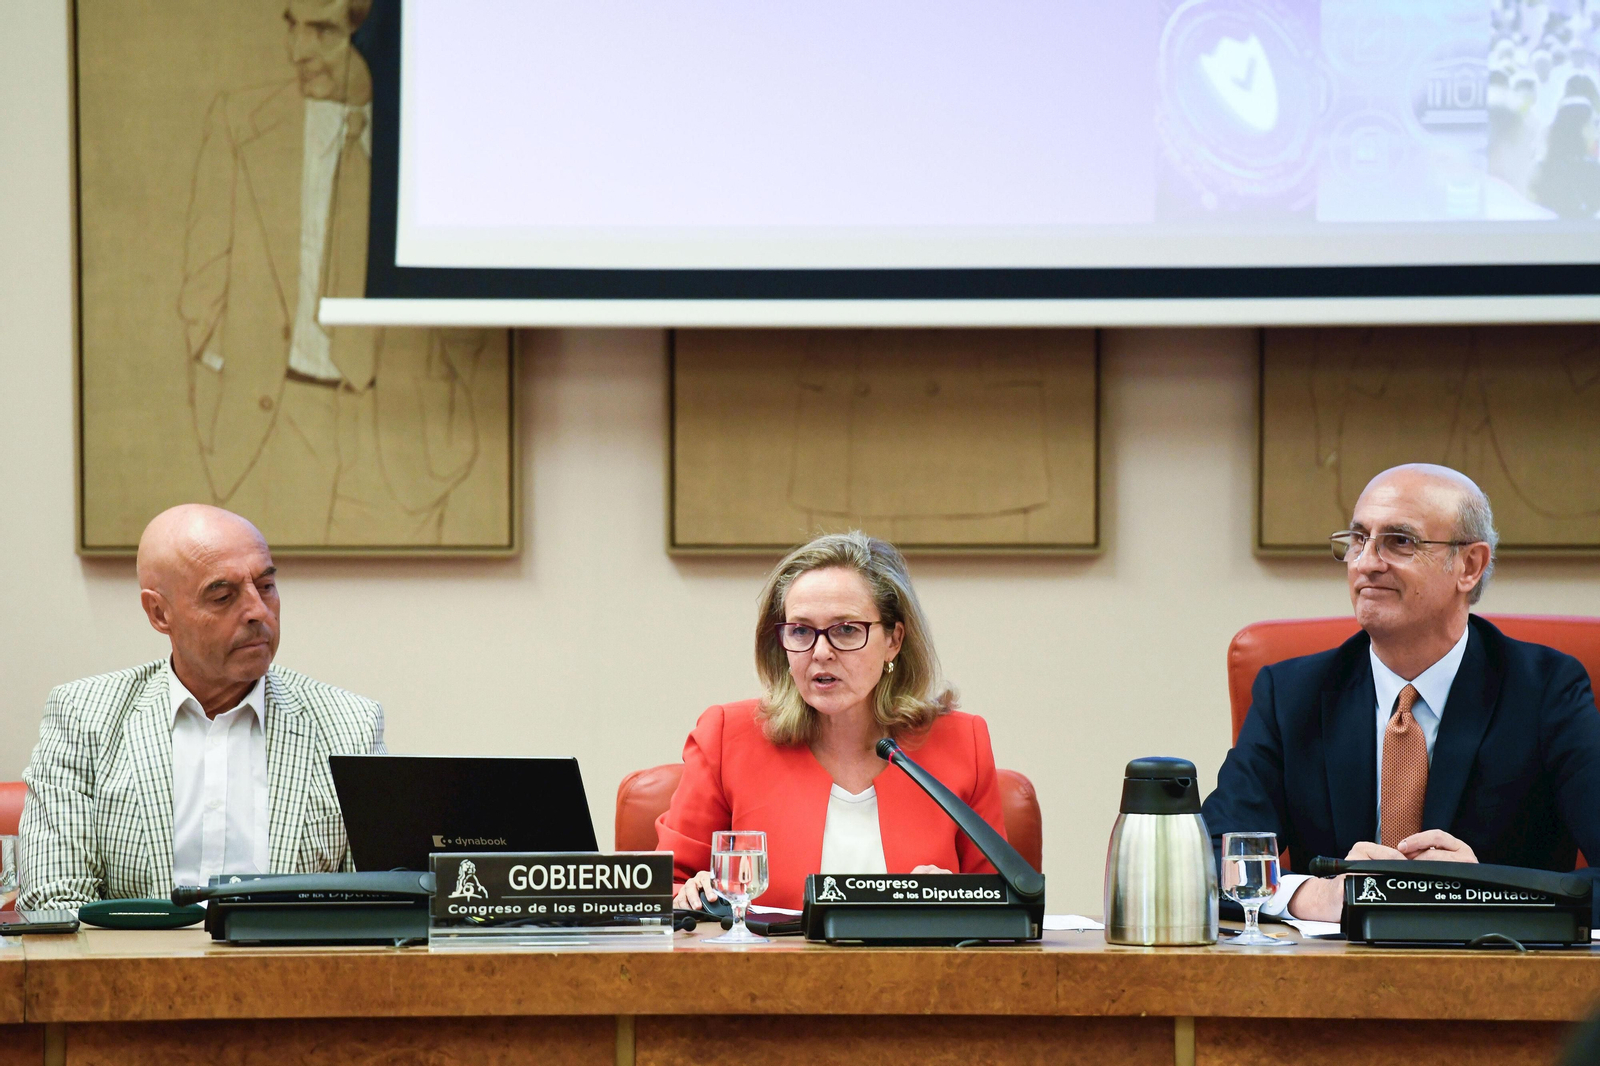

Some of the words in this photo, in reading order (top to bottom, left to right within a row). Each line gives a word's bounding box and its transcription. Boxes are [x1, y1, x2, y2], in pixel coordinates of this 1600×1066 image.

[455, 836, 507, 847] dynabook
[508, 863, 653, 891] GOBIERNO
[845, 878, 919, 892] Congreso
[1386, 878, 1462, 891] Congreso
[892, 892, 904, 900] de
[906, 892, 919, 900] los
[922, 887, 1001, 901] Diputados
[1434, 892, 1447, 900] de
[1449, 892, 1462, 900] los
[448, 904, 522, 915] Congreso
[528, 903, 547, 913] de
[553, 903, 576, 913] los
[583, 902, 662, 914] Diputados
